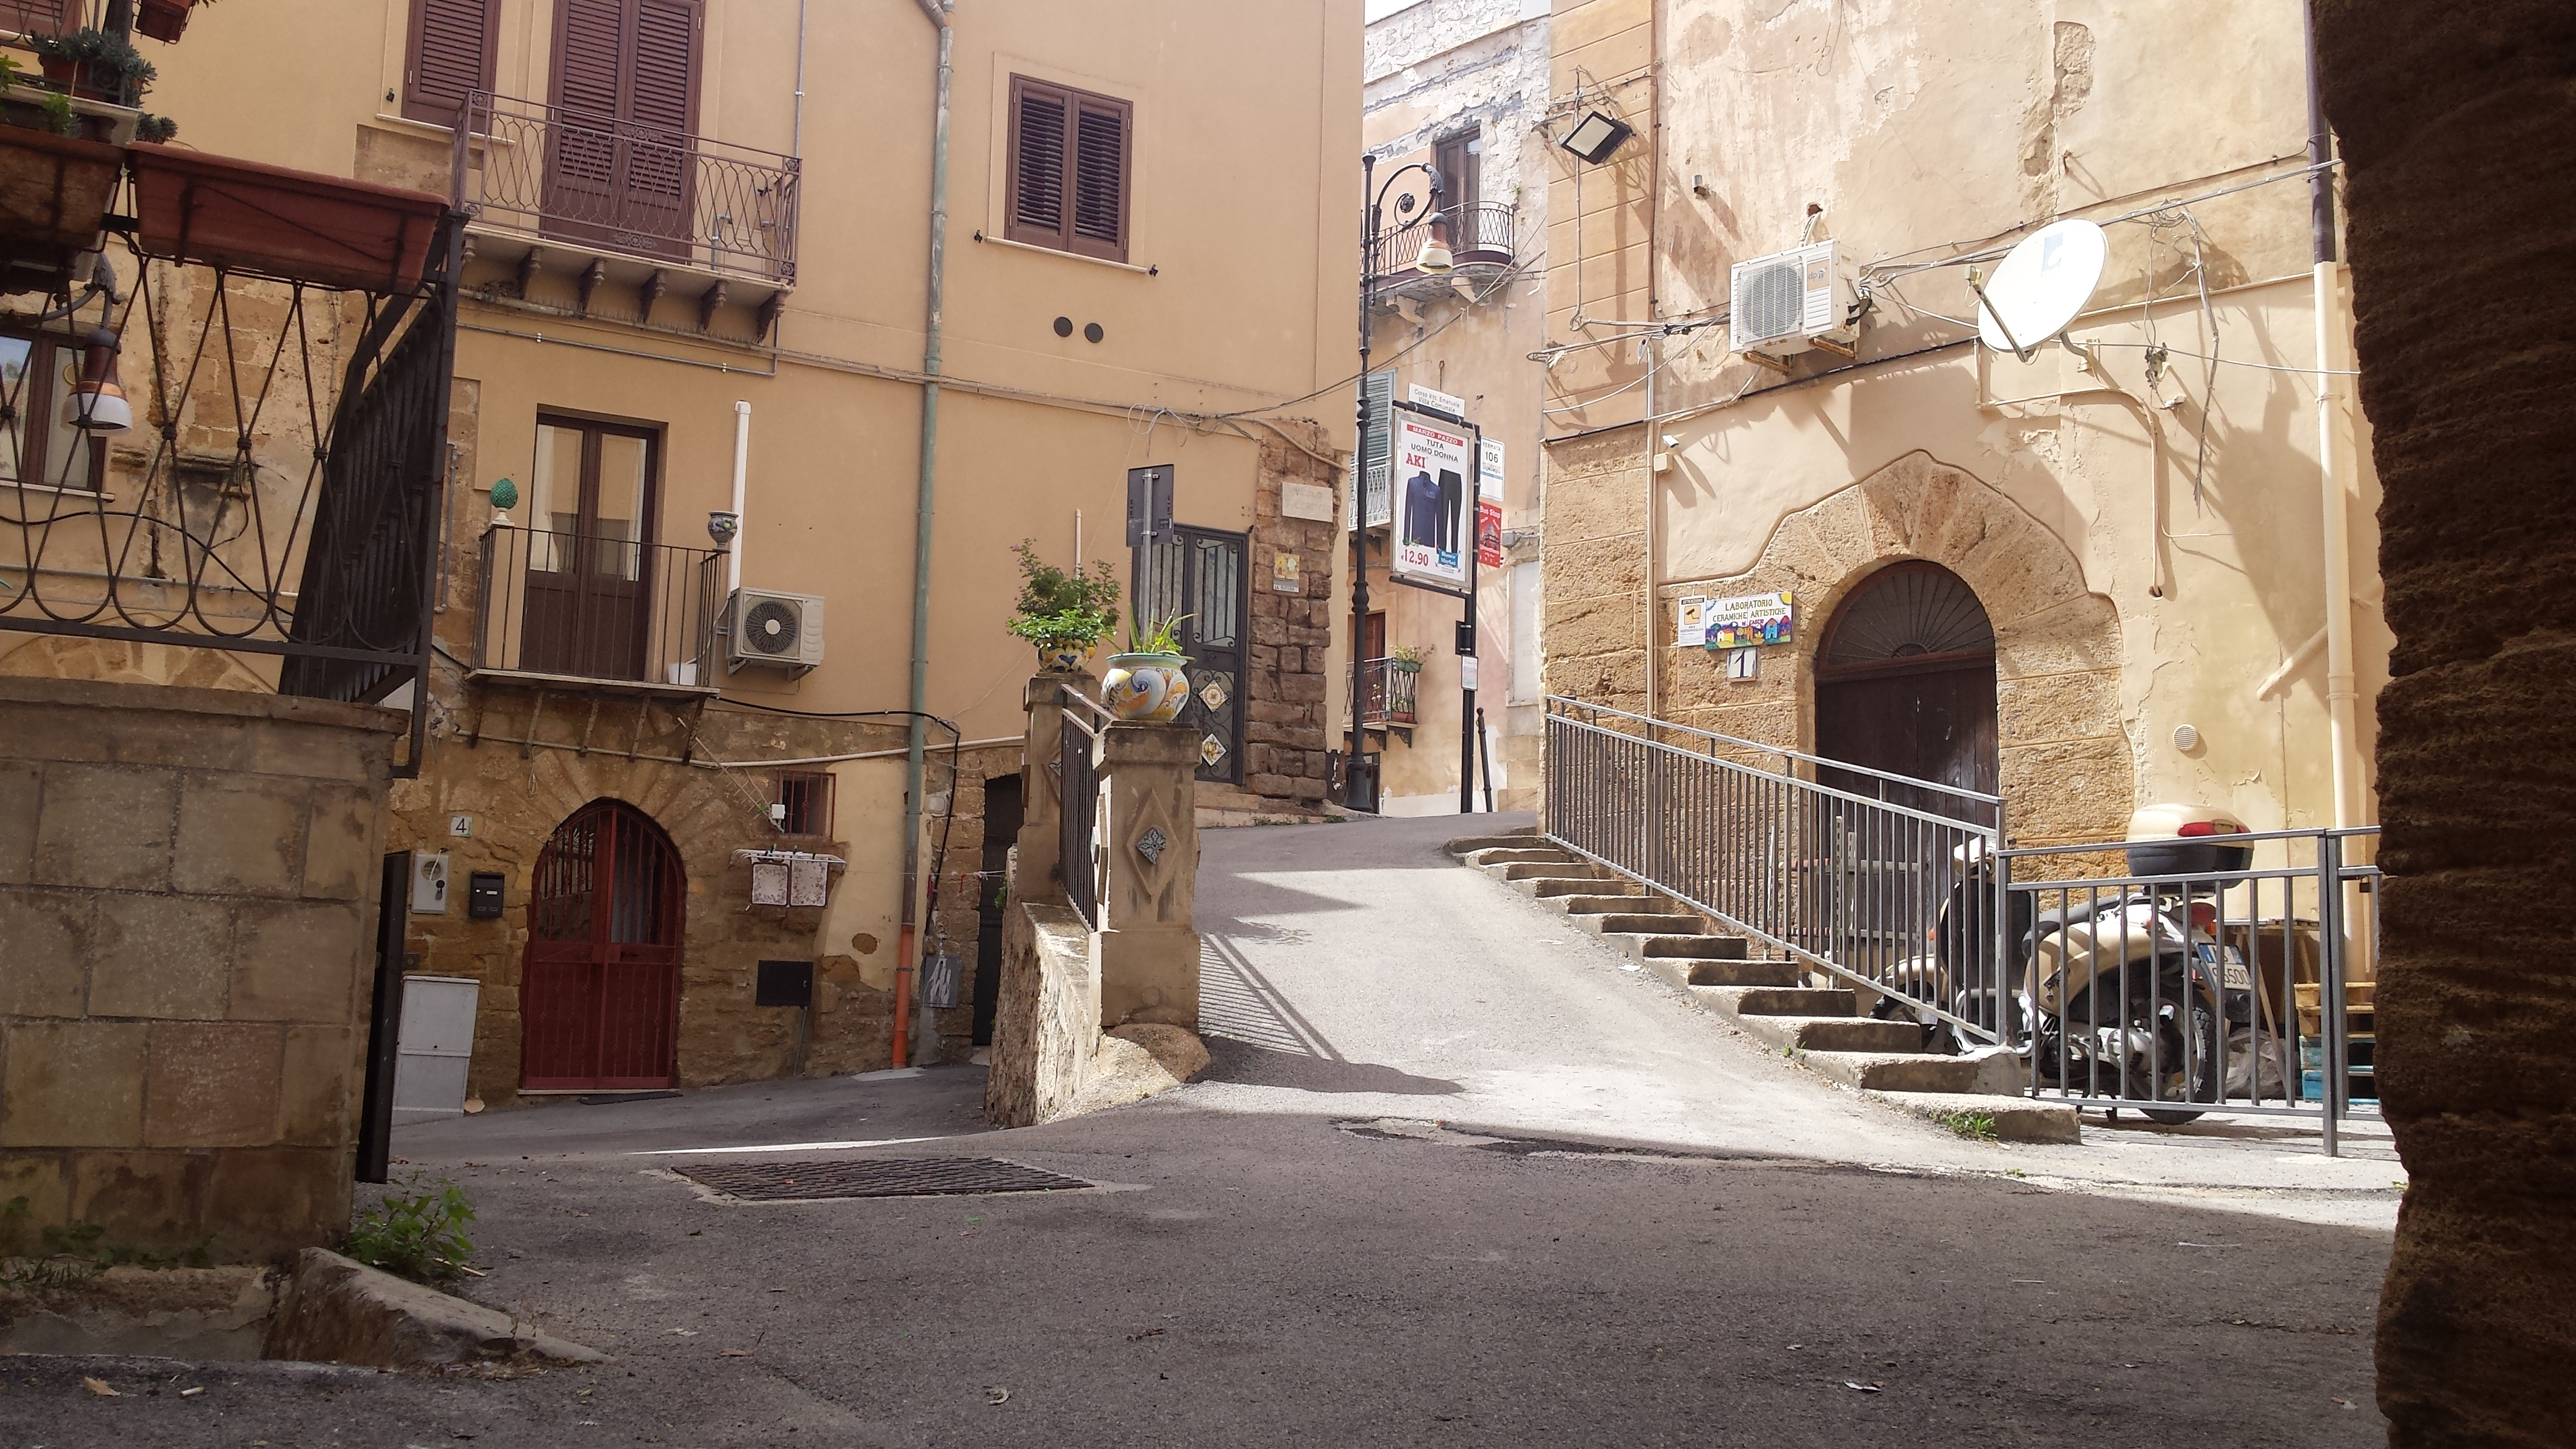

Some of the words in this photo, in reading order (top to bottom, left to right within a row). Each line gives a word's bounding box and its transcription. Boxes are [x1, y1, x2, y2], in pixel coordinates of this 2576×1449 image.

[1414, 389, 1428, 398] Corso
[1418, 397, 1430, 406] Villa
[1412, 426, 1435, 437] MARZO
[1437, 434, 1458, 444] PAZZO
[1426, 439, 1444, 449] TUTA
[1411, 442, 1432, 454] UOMO
[1434, 450, 1458, 462] DONNA
[1485, 451, 1498, 463] 106
[1406, 452, 1426, 469] AKI
[1480, 505, 1489, 515] Bus
[1489, 509, 1501, 519] Stop
[1725, 599, 1773, 611] LABORATORIO
[1713, 612, 1747, 622] CERAMICHE
[1750, 608, 1786, 618] ARTISTICHE
[1734, 650, 1749, 678] 1
[456, 818, 467, 833] 4
